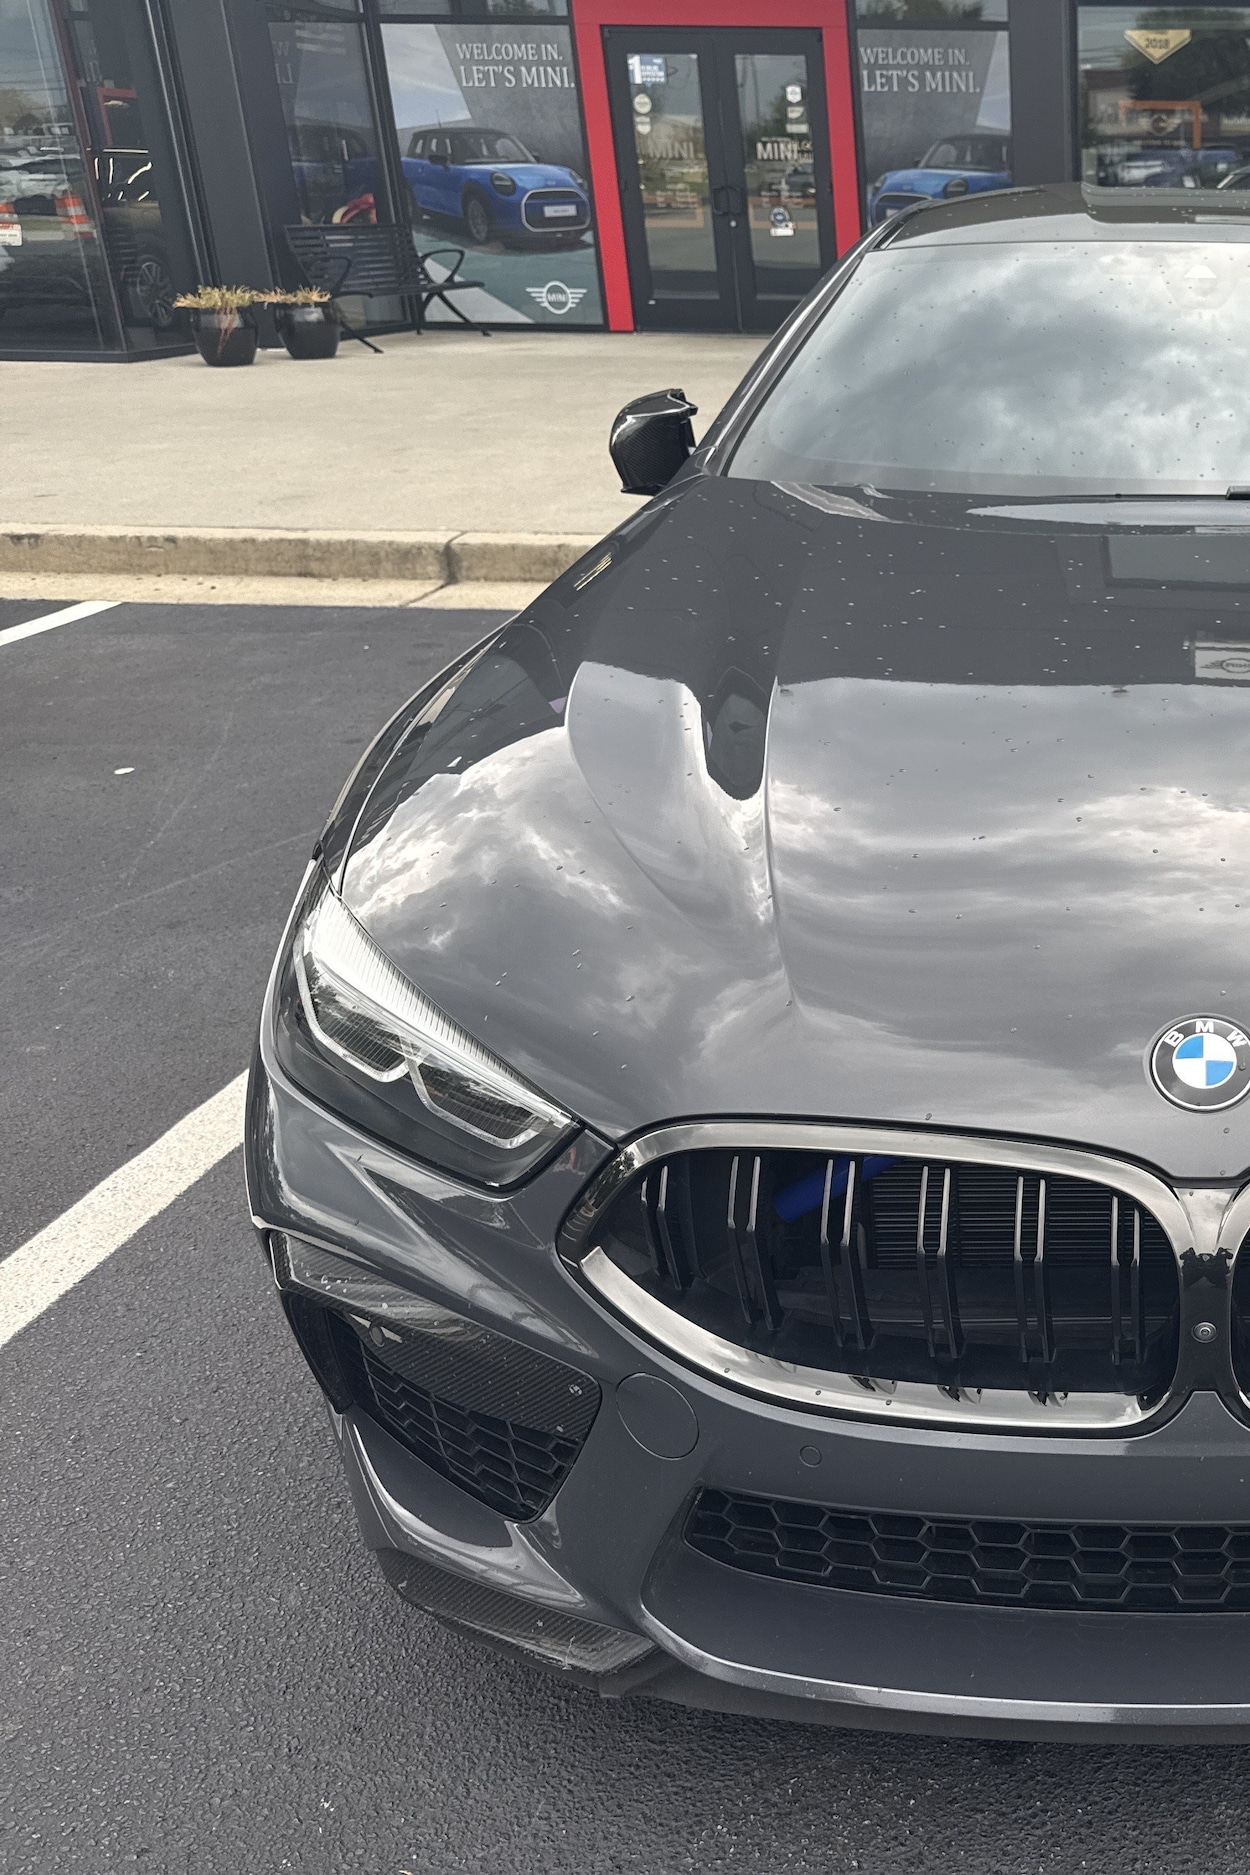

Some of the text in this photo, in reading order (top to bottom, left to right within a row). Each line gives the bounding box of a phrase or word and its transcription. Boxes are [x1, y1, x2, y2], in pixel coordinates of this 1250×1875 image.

[456, 43, 563, 60] WELCOME IN.
[860, 47, 970, 65] WELCOME IN.
[460, 65, 575, 88] LET'S MINI.
[862, 70, 980, 93] LET'S MINI.
[756, 141, 798, 160] MINI
[547, 292, 568, 302] MINI
[1164, 1020, 1248, 1048] BMW
